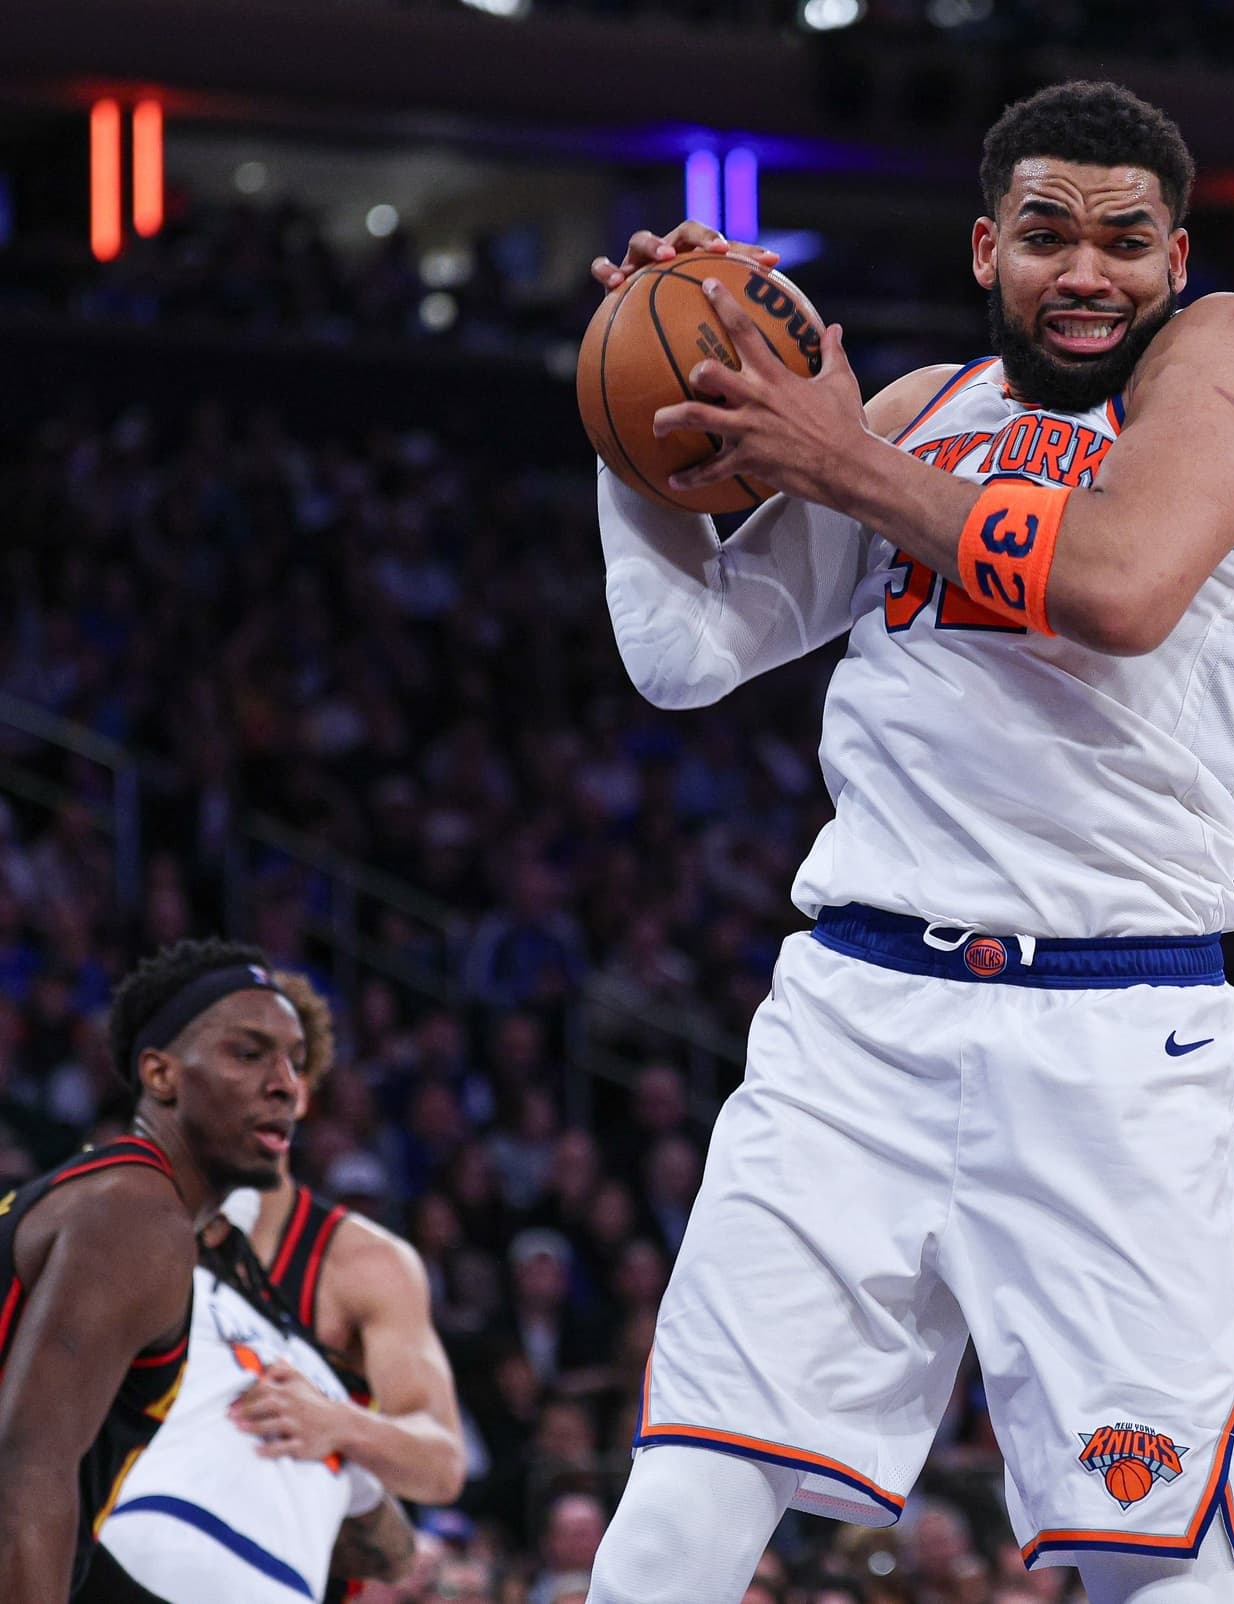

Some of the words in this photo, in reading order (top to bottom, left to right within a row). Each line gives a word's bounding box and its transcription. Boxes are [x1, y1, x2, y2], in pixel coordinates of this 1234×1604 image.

[975, 508, 1040, 611] 32
[968, 947, 1002, 968] KNICKS
[1114, 1421, 1133, 1430] NEW
[1134, 1423, 1156, 1435] YORK
[1079, 1425, 1183, 1475] KNICKS
